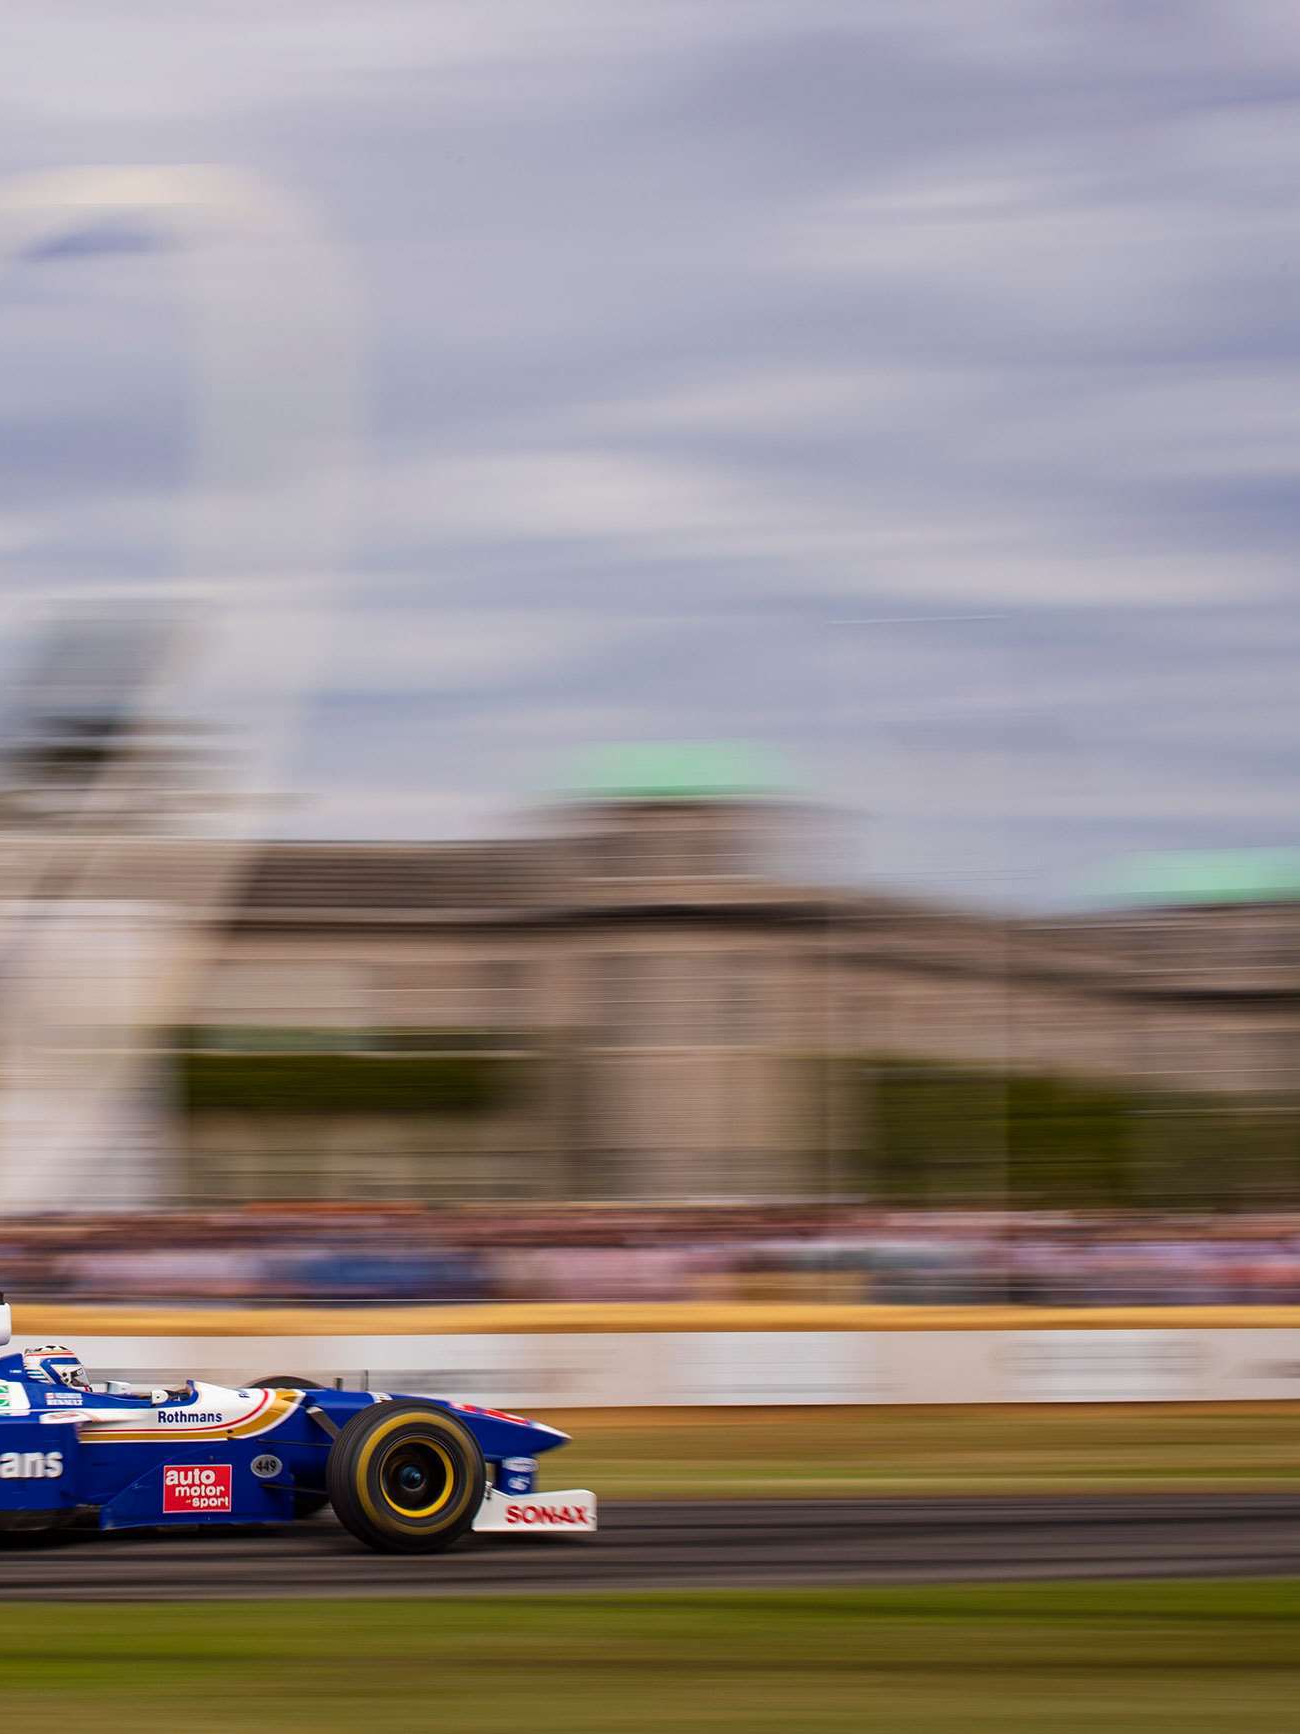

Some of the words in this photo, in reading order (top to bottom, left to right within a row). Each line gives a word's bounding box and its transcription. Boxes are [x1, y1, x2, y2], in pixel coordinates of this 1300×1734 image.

[157, 1410, 222, 1424] Rothmans
[255, 1460, 277, 1472] 449
[165, 1468, 216, 1485] auto
[175, 1485, 225, 1497] motor
[192, 1497, 229, 1508] sport
[506, 1505, 588, 1524] SONAX
